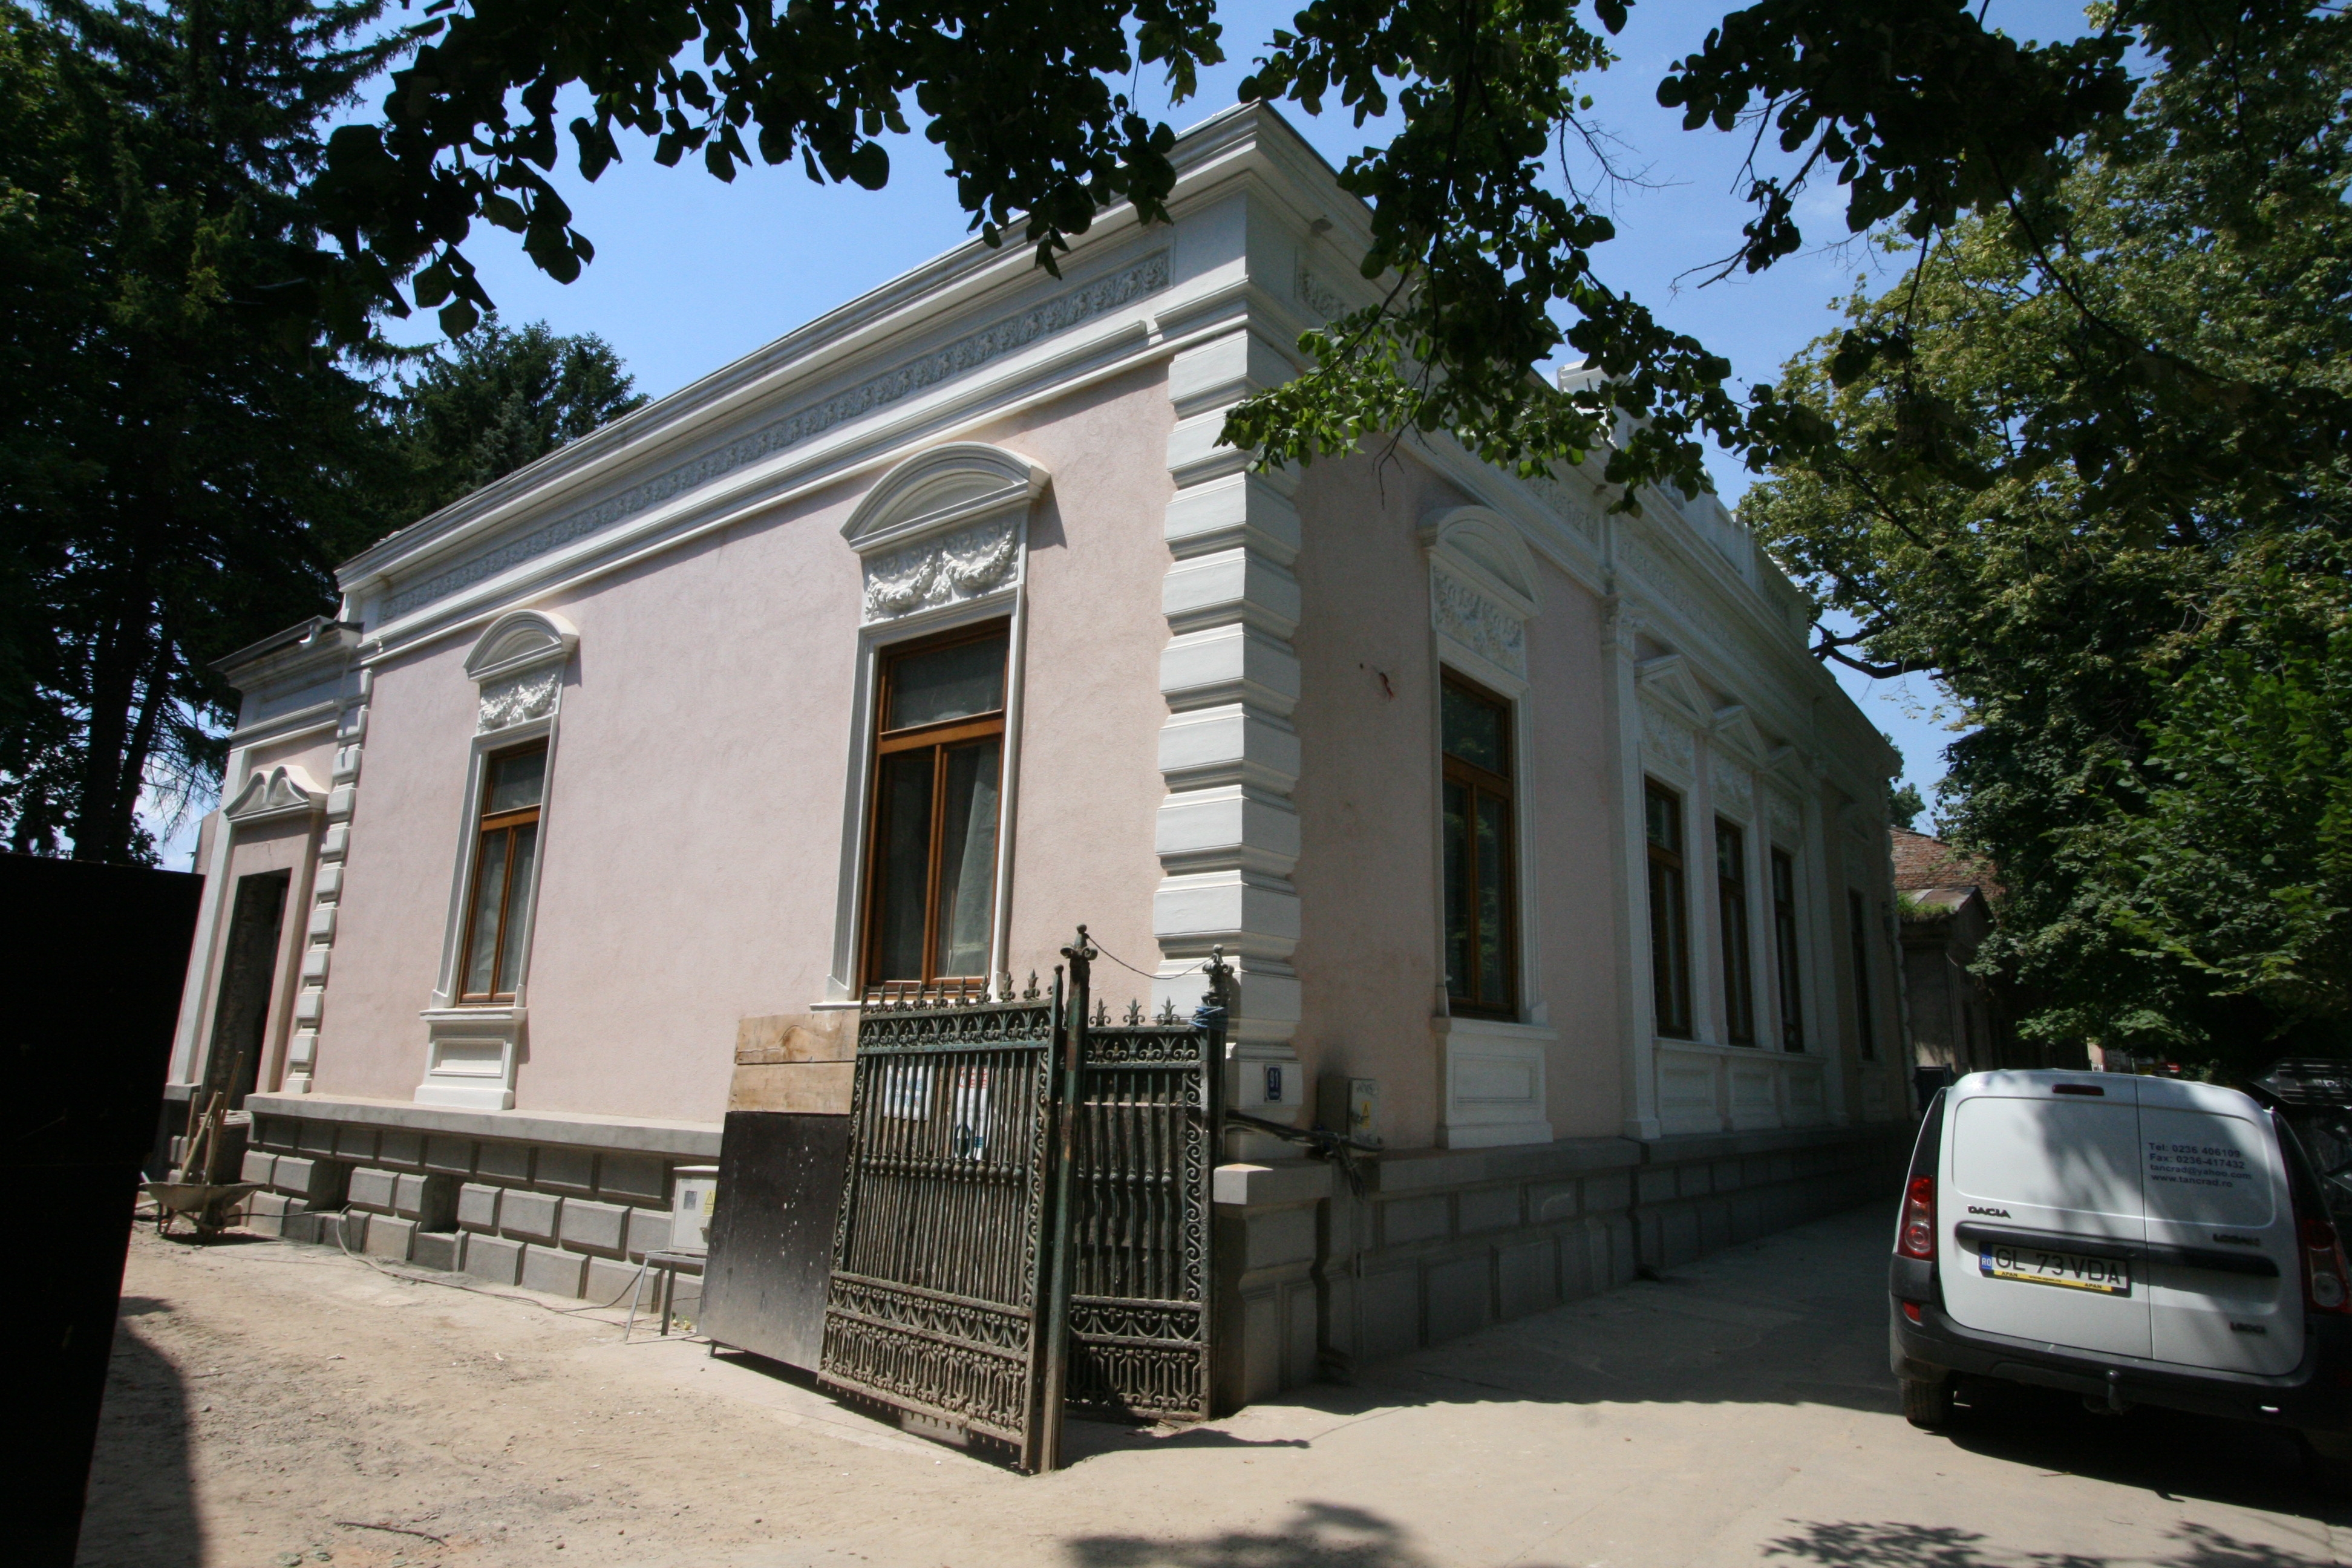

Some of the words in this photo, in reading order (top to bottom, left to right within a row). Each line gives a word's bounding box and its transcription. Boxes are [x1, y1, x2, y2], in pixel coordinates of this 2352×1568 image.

[1270, 1070, 1278, 1088] 91
[2149, 1142, 2169, 1151] Tel:
[2172, 1145, 2198, 1154] 0236
[2201, 1148, 2241, 1158] 406109
[2149, 1153, 2172, 1162] Fax:
[2176, 1155, 2245, 1169] 0236-417432
[2151, 1164, 2252, 1180] tancrad@yahoo.com
[2151, 1174, 2233, 1187] www.tancrad.ro
[1967, 1206, 2011, 1218] DACIA
[1981, 1257, 1992, 1267] RO
[1995, 1248, 2026, 1271] GL
[2036, 1254, 2064, 1276] 73
[2069, 1256, 2121, 1285] VDA
